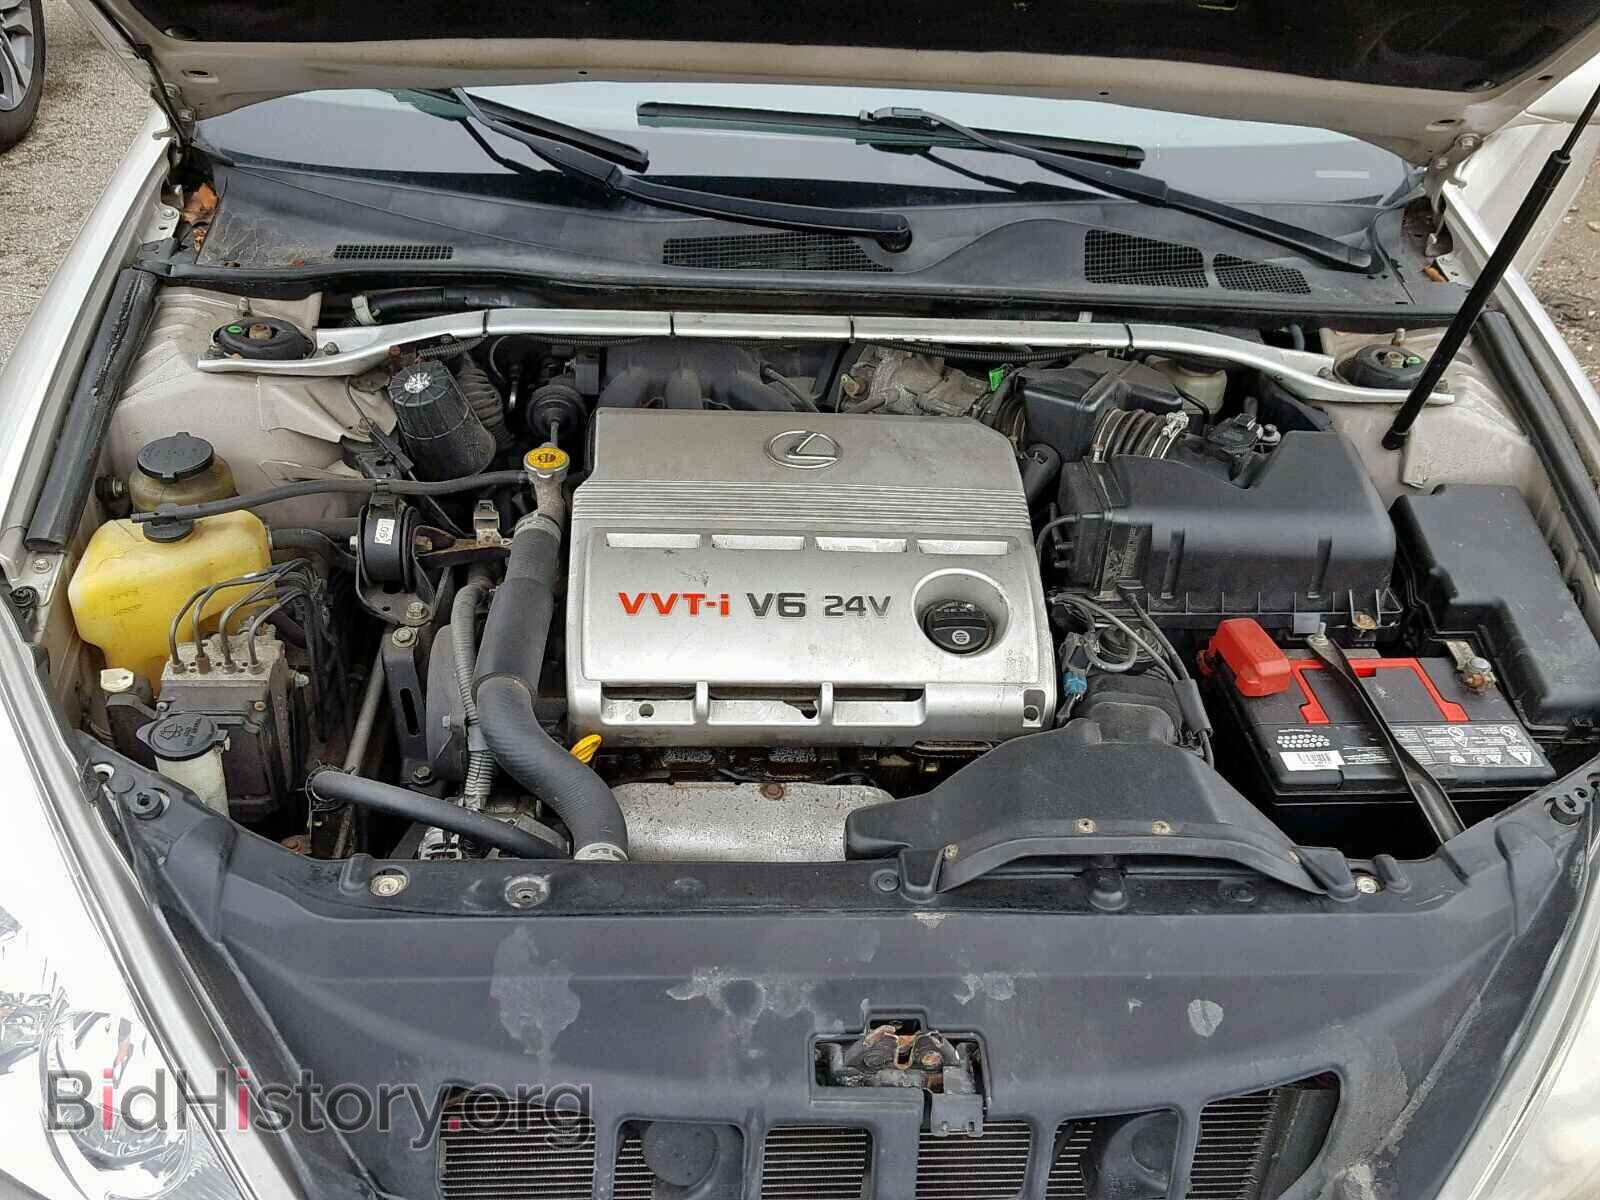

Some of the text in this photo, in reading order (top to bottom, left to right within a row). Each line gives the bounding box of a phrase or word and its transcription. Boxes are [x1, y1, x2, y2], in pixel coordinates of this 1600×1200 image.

[618, 592, 892, 618] VVT-i V6 24V
